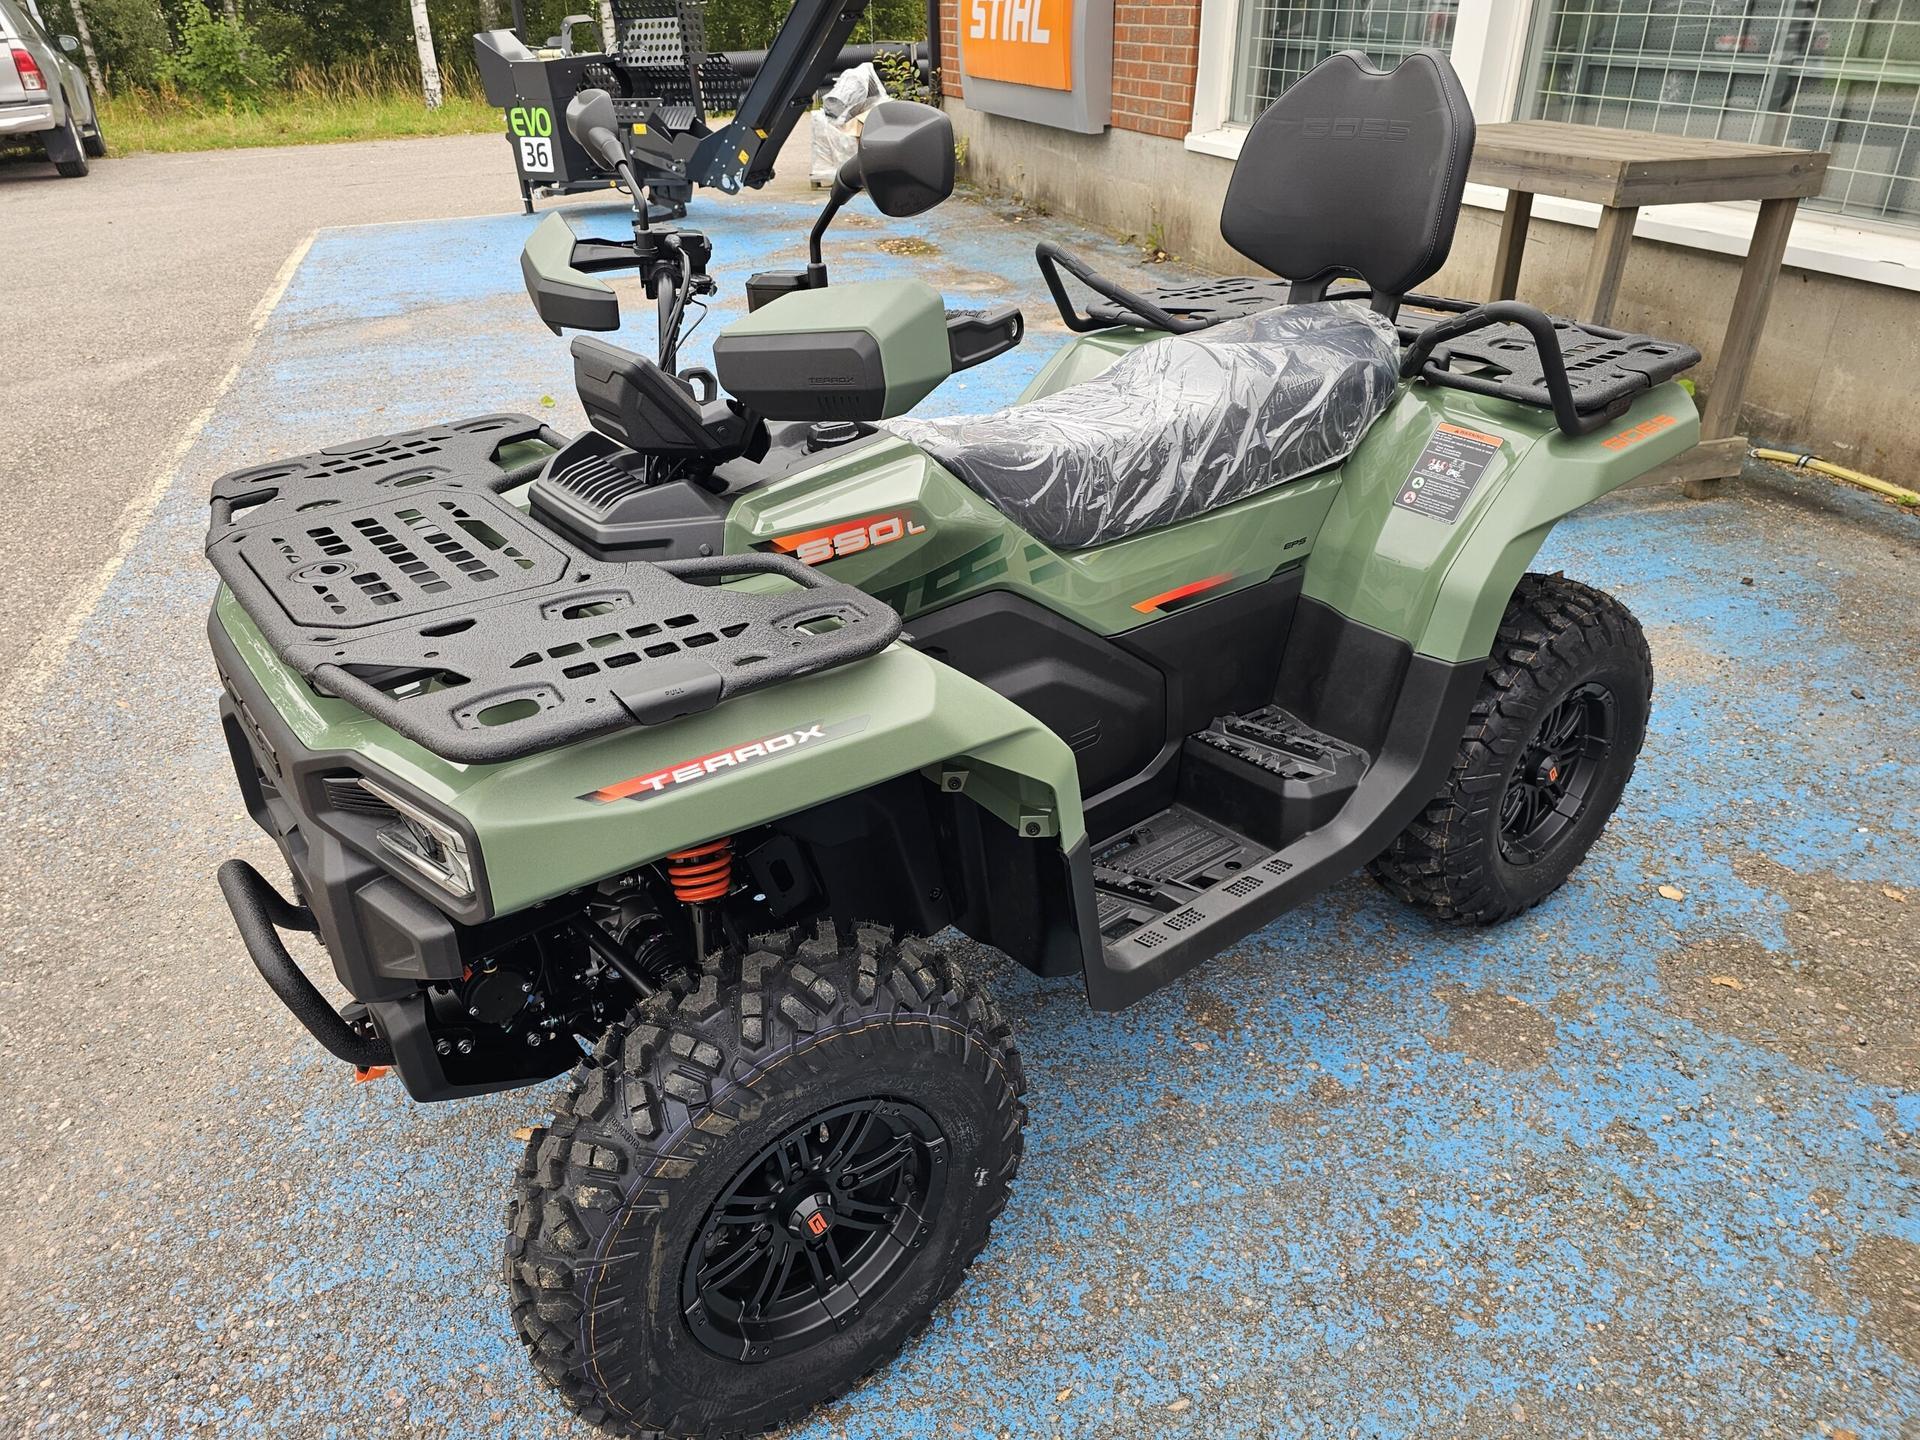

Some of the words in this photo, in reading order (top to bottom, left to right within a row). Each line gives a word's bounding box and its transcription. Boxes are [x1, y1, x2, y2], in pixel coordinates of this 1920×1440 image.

[970, 0, 1049, 43] STIHL
[510, 107, 552, 136] EVO
[524, 142, 548, 167] 36
[1283, 536, 1308, 550] EPS
[640, 724, 826, 791] TERROX
